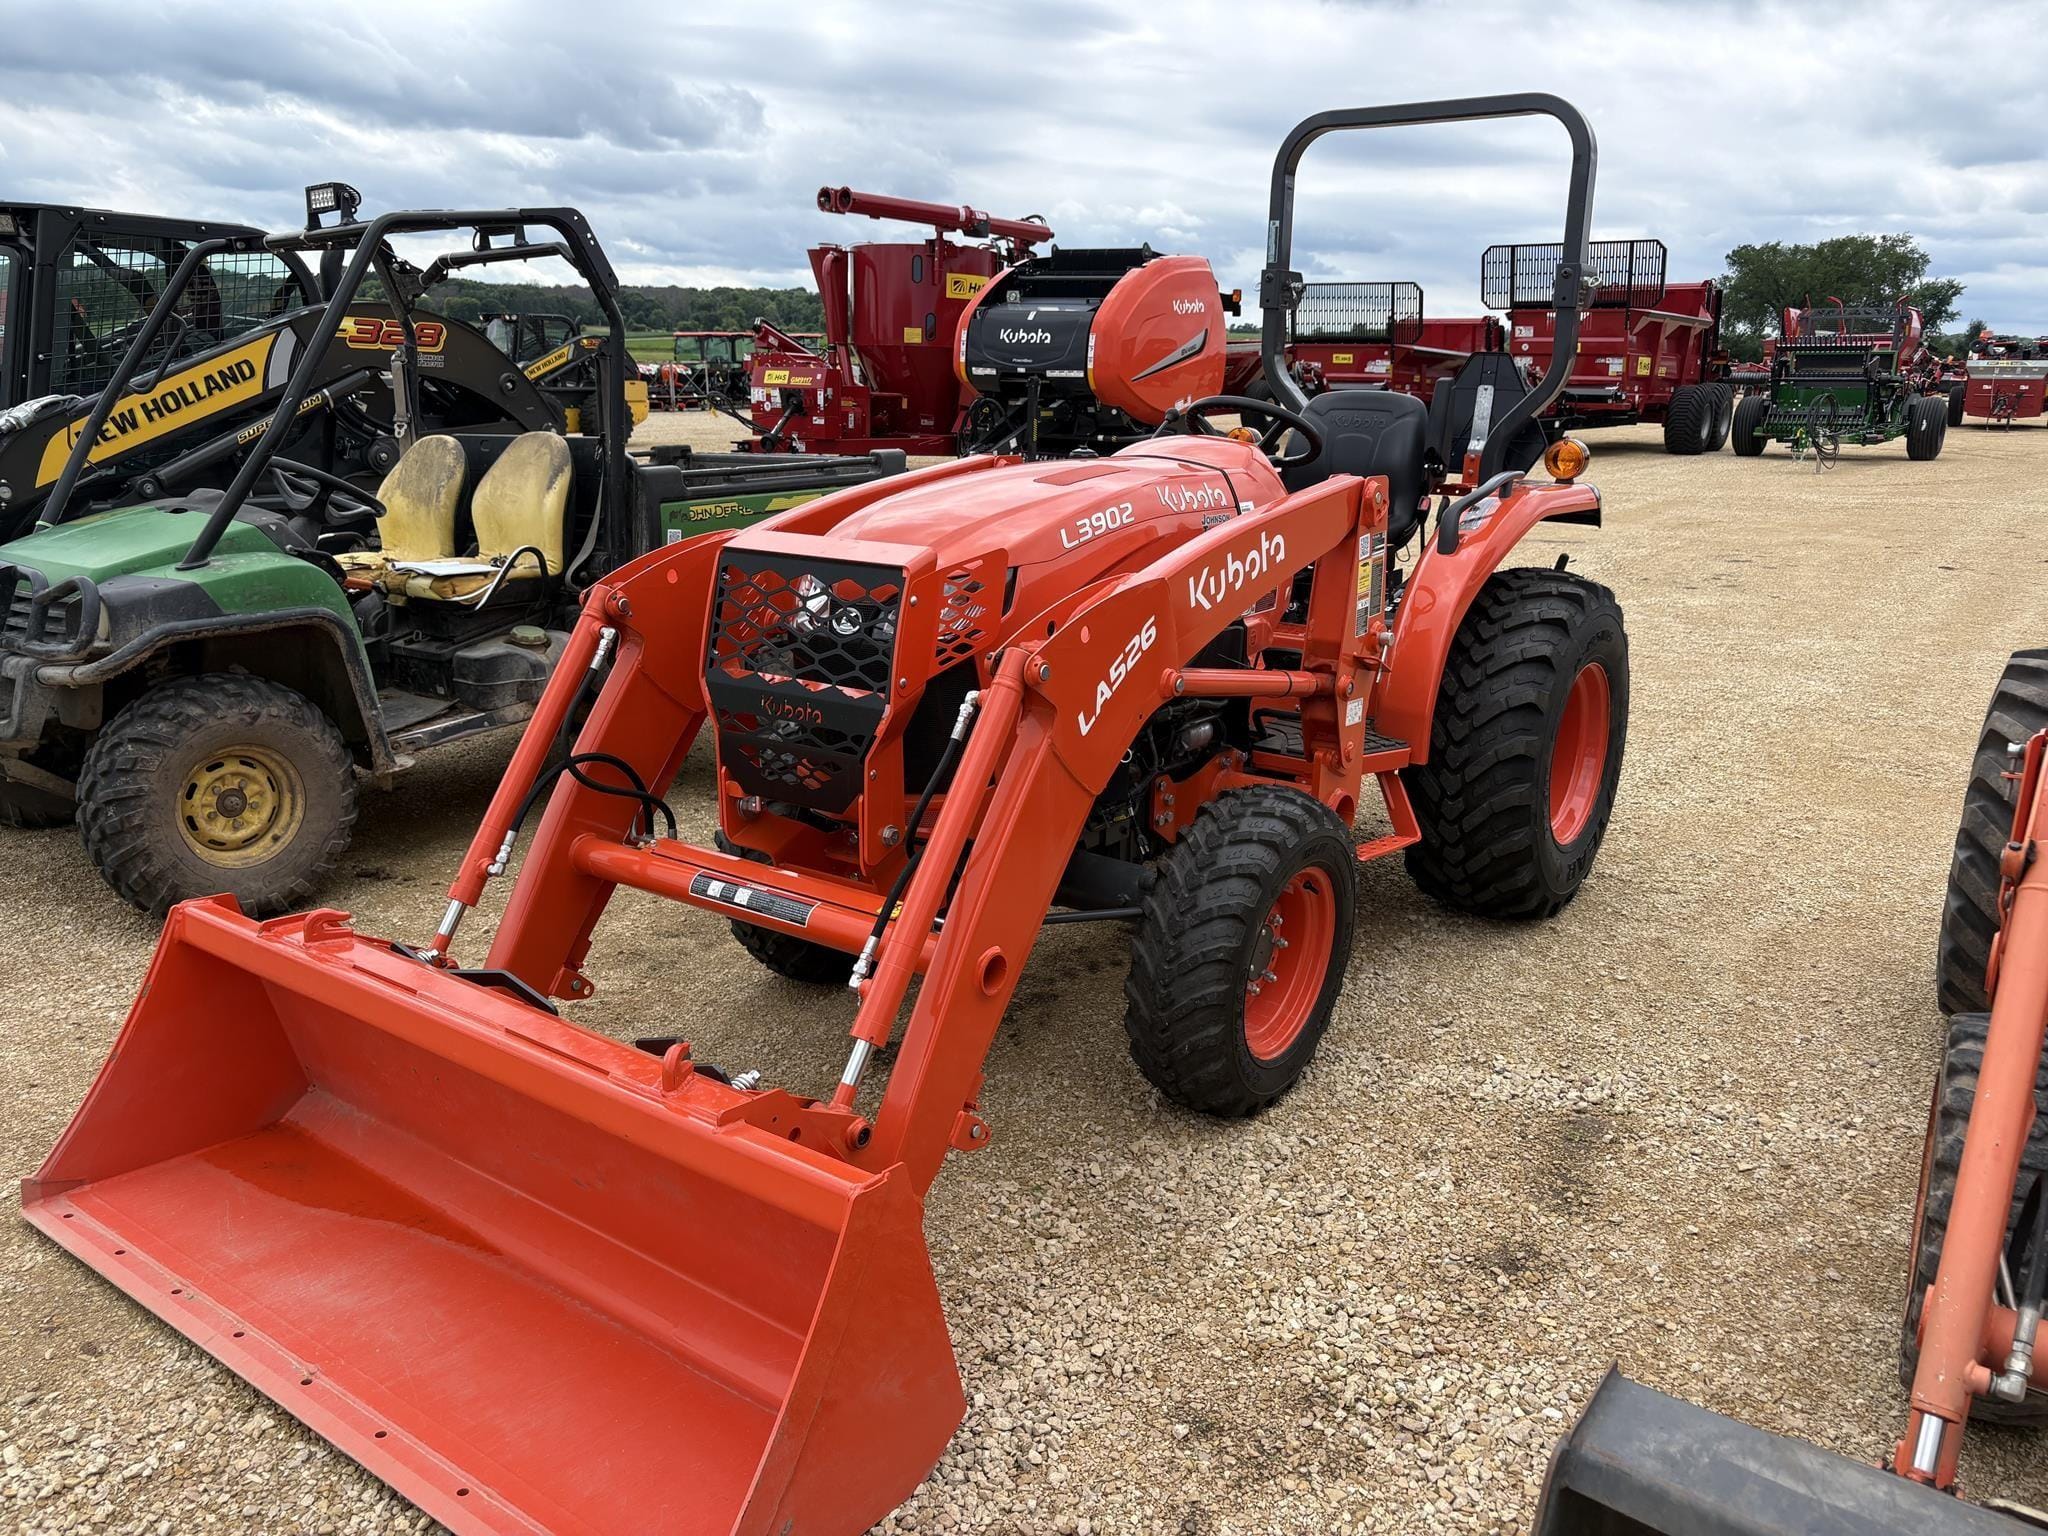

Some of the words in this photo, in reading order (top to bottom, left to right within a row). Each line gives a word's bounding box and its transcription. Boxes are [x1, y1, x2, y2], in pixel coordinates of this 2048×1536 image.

[1172, 298, 1205, 315] Kubota
[347, 318, 446, 349] 328
[1000, 328, 1051, 344] Kubota
[140, 358, 256, 423] HOLLAND
[1332, 414, 1386, 430] Kubota
[1155, 482, 1228, 512] Kubota
[1060, 502, 1135, 549] L3902
[1201, 513, 1231, 526] JOHNSON
[1188, 531, 1286, 610] Kubota
[1077, 614, 1157, 737] LA526
[761, 694, 824, 724] Kubota
